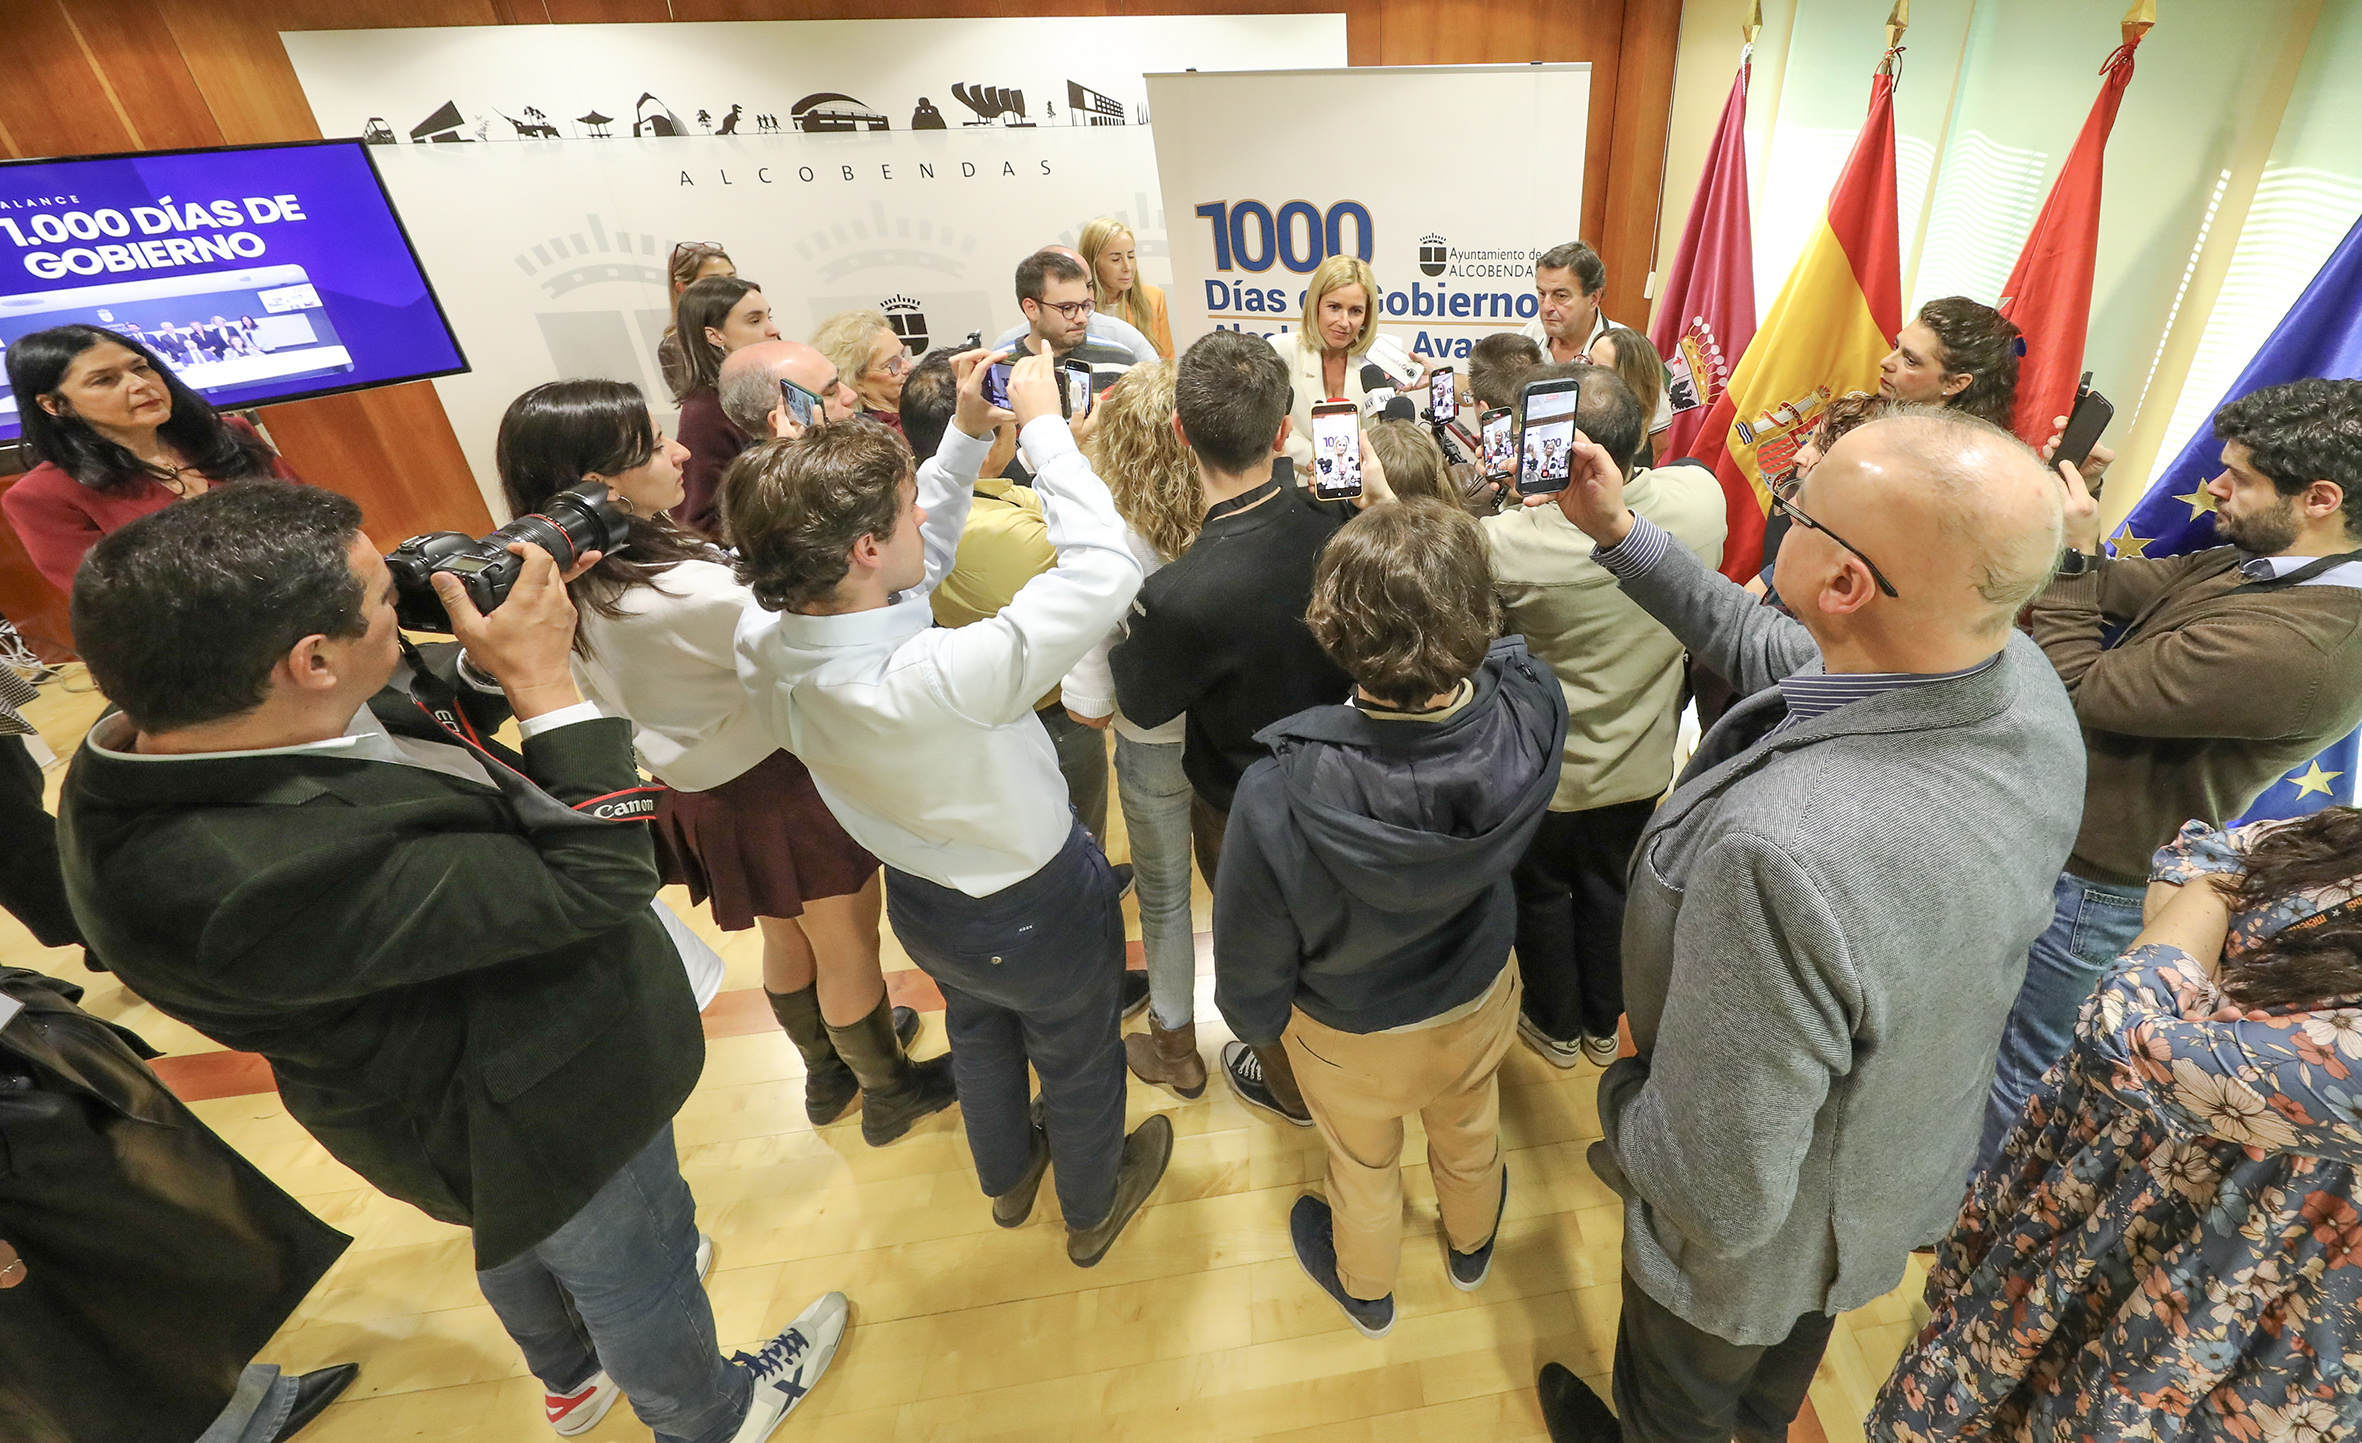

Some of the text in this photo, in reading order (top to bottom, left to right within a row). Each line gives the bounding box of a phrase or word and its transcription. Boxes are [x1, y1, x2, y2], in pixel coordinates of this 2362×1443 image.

[680, 160, 1052, 186] ALCOBENDAS
[0, 194, 307, 248] 1.000 DÍAS DE
[1194, 198, 1375, 275] 1000
[23, 231, 266, 280] GOBIERNO
[1449, 247, 1542, 263] Ayuntamiento de
[1449, 265, 1538, 278] ALCOBENDA
[1205, 279, 1287, 313] Días
[1413, 331, 1483, 359] Ava
[593, 799, 654, 819] Canon
